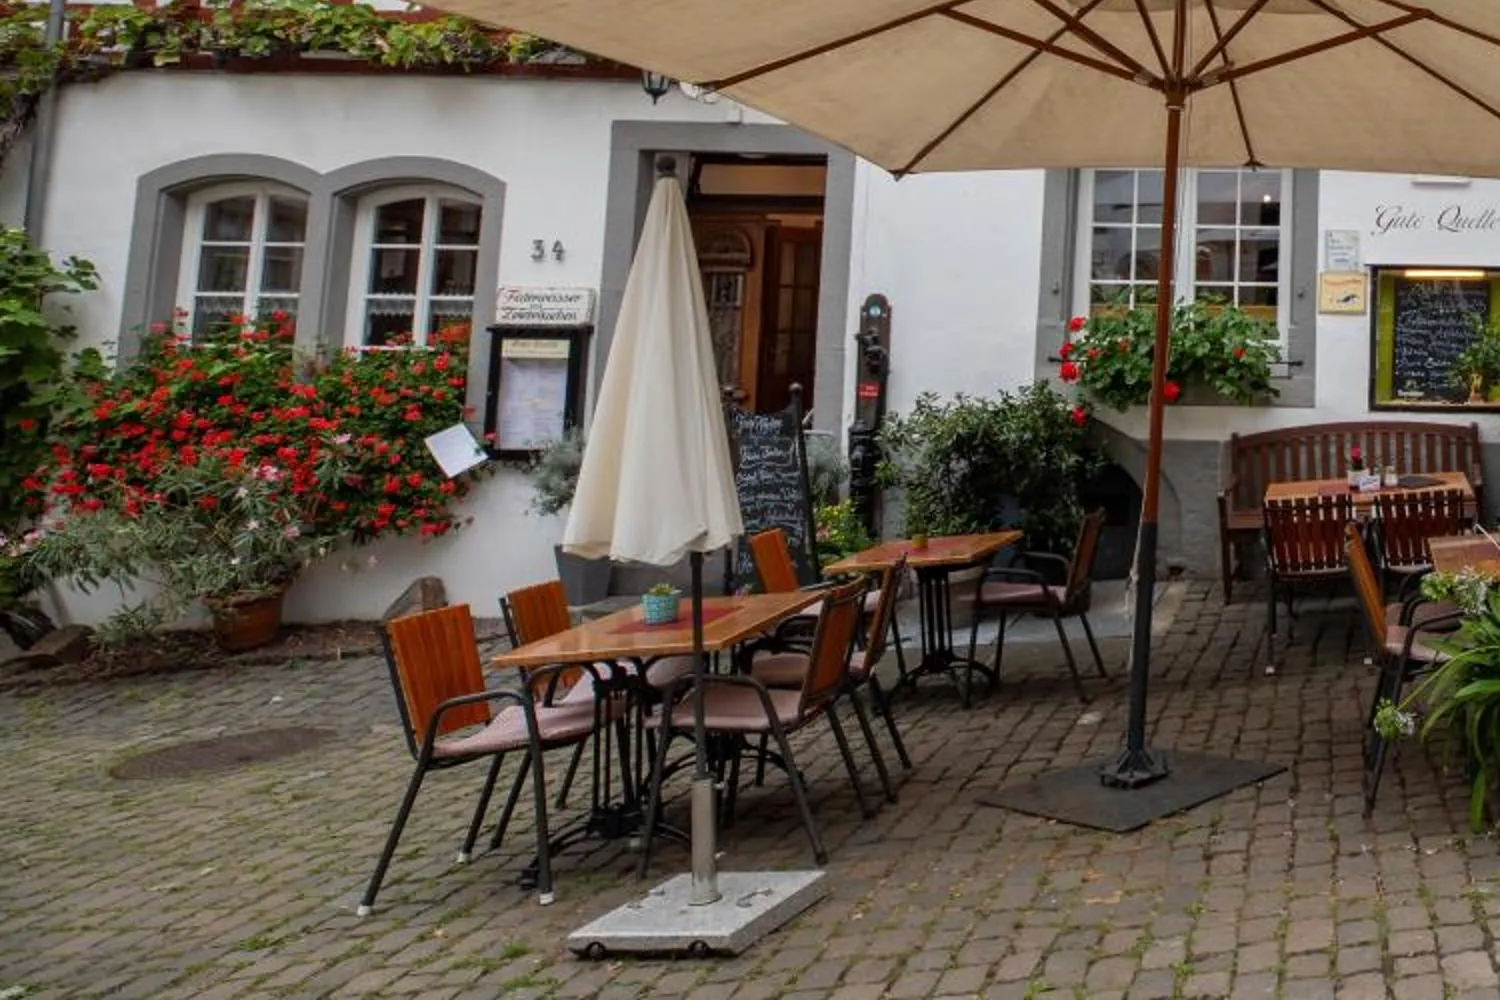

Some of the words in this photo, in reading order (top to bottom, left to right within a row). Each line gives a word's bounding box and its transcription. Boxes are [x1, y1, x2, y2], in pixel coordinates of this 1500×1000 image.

[1375, 205, 1421, 233] Gute
[1437, 204, 1500, 233] Quelle
[530, 238, 566, 262] 34
